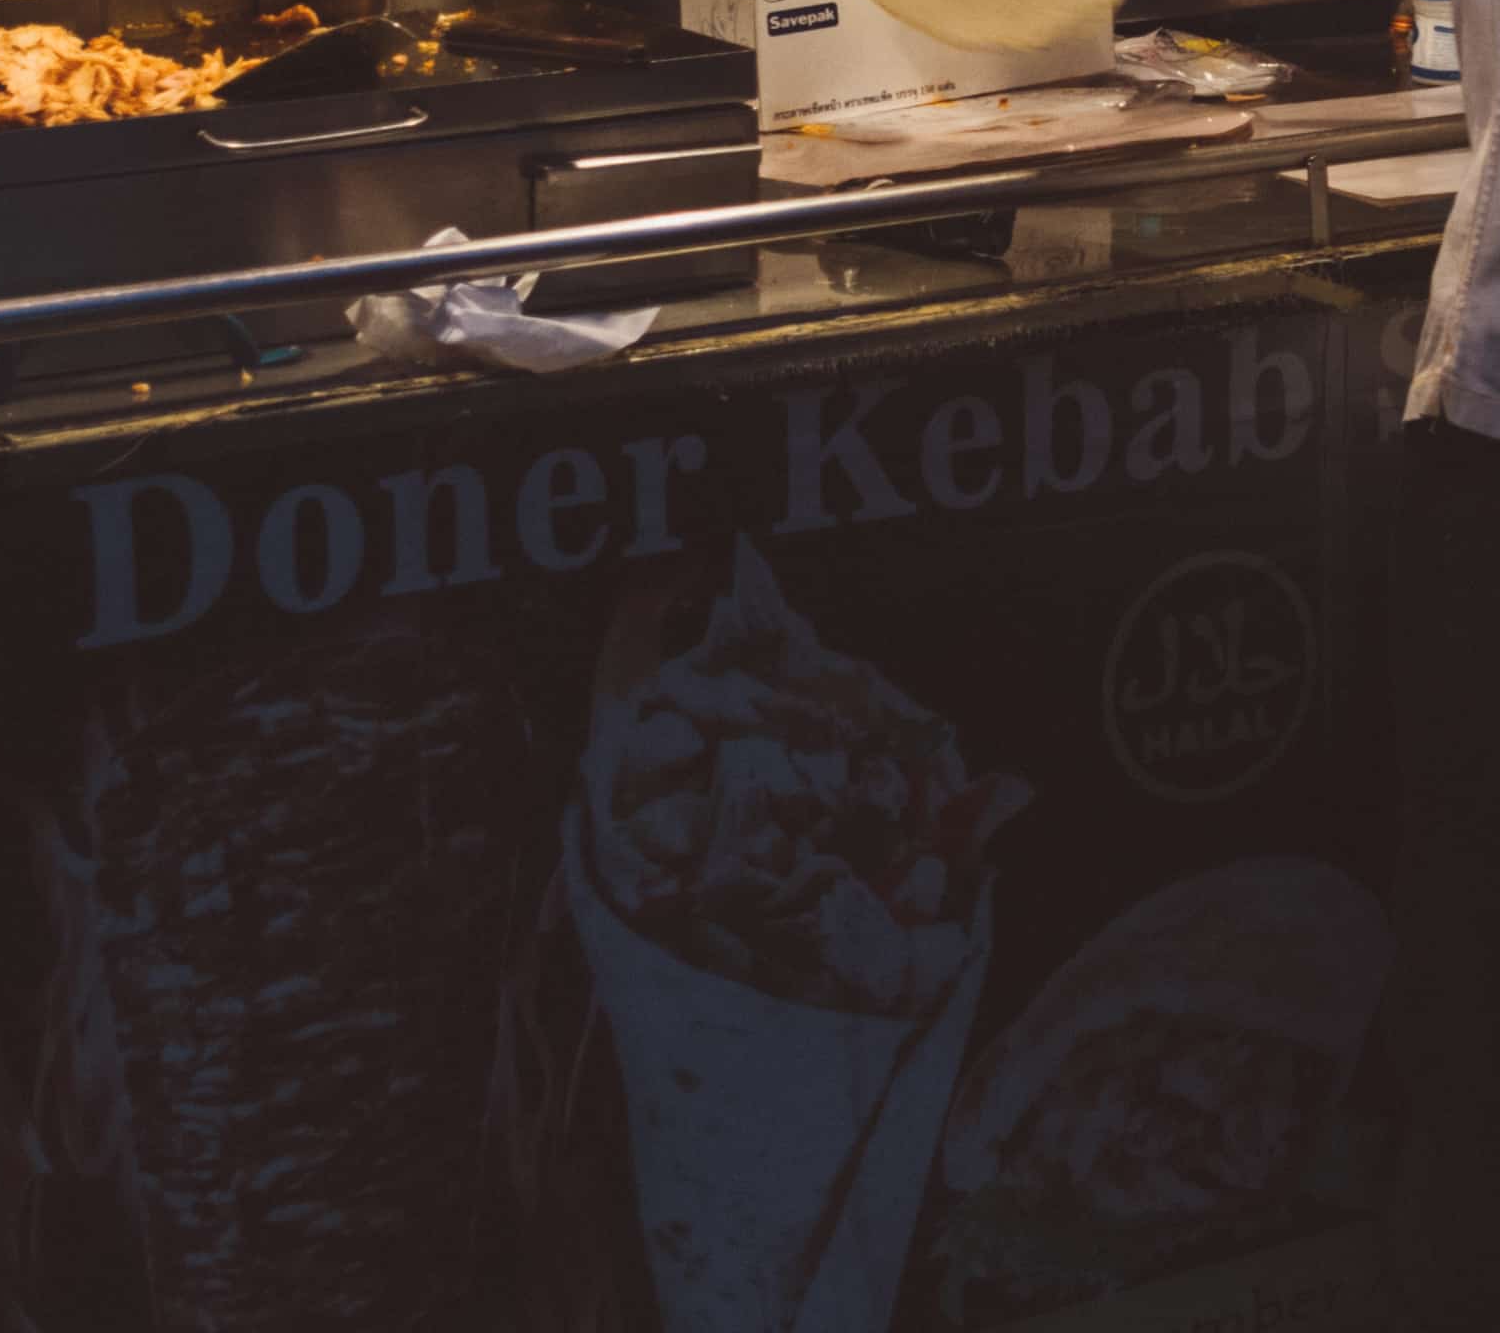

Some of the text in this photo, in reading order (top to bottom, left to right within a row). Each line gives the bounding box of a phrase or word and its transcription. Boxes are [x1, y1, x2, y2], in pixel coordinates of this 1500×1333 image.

[769, 7, 836, 30] Savepak
[70, 328, 1315, 650] Doner Kebab
[1138, 703, 1278, 765] HALAL
